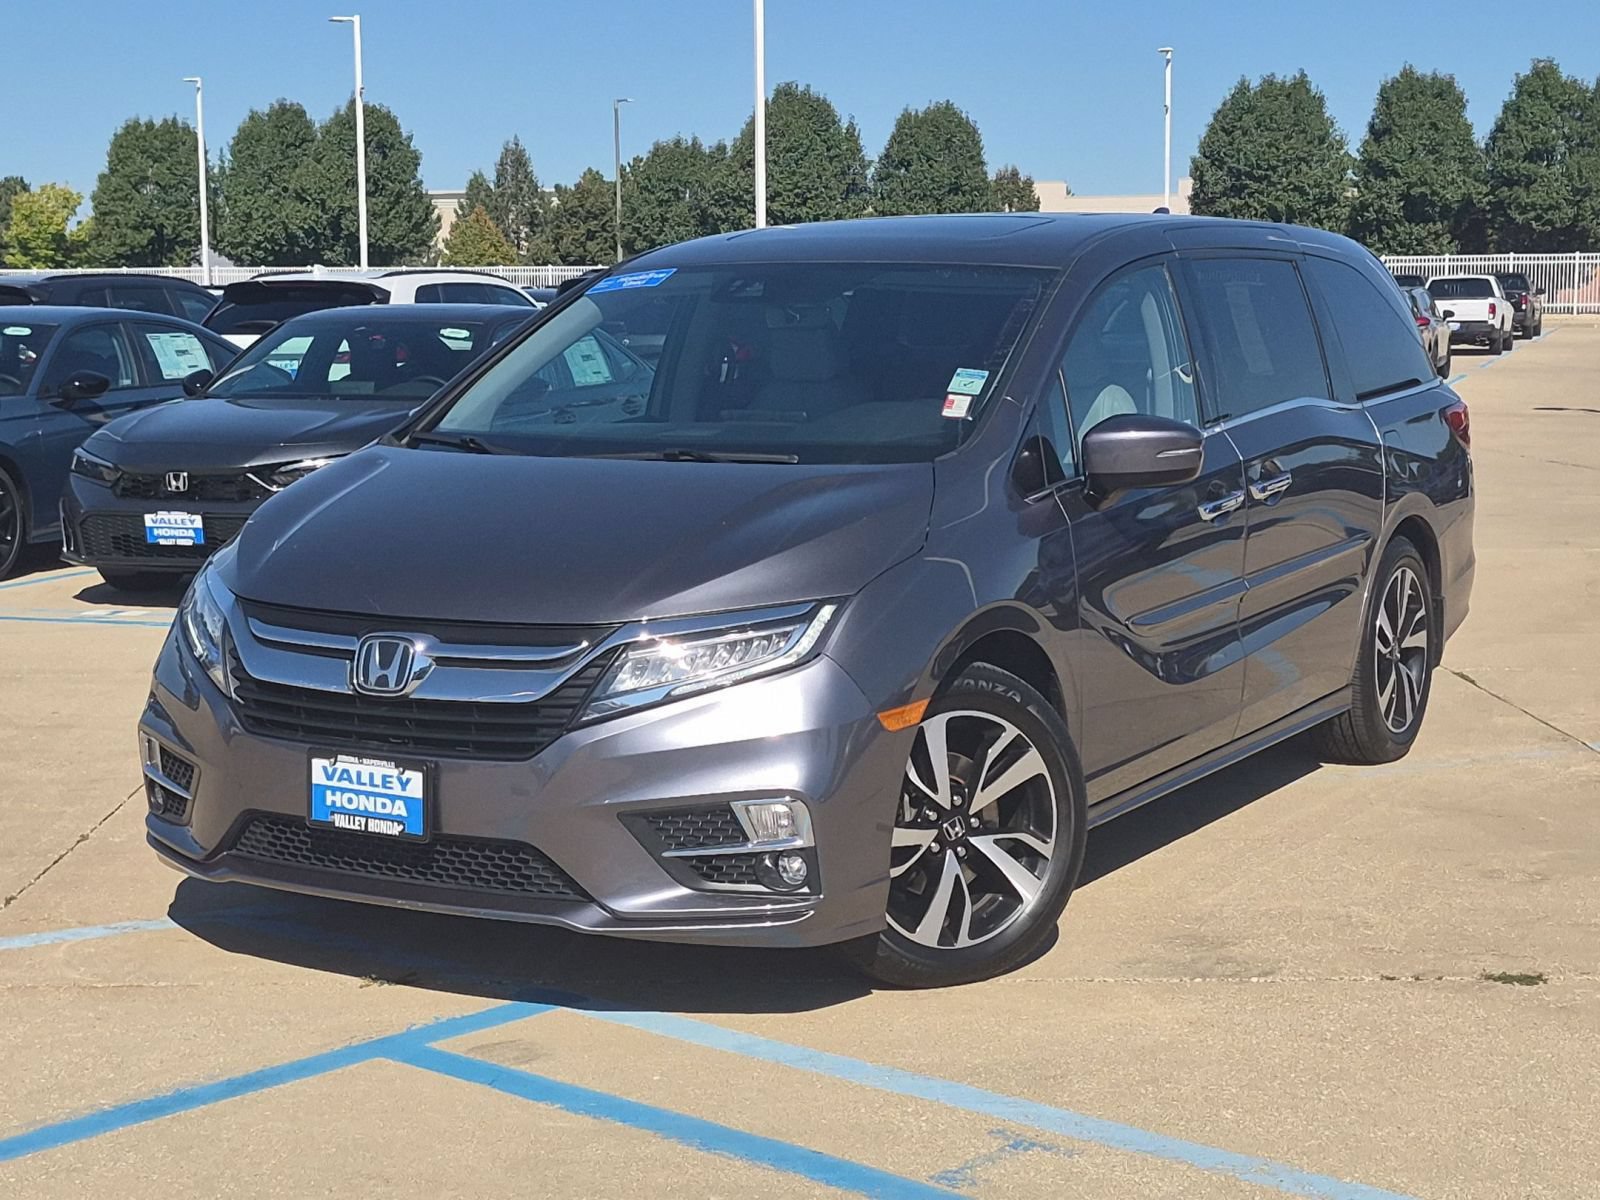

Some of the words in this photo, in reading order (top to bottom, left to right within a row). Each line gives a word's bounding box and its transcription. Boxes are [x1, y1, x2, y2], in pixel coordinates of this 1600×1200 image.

[151, 518, 196, 526] VALLEY
[153, 527, 196, 538] HONDA
[321, 765, 413, 792] VALLEY
[325, 789, 408, 818] HONDA
[334, 813, 367, 830] VALLEY
[368, 818, 400, 836] HONDA
